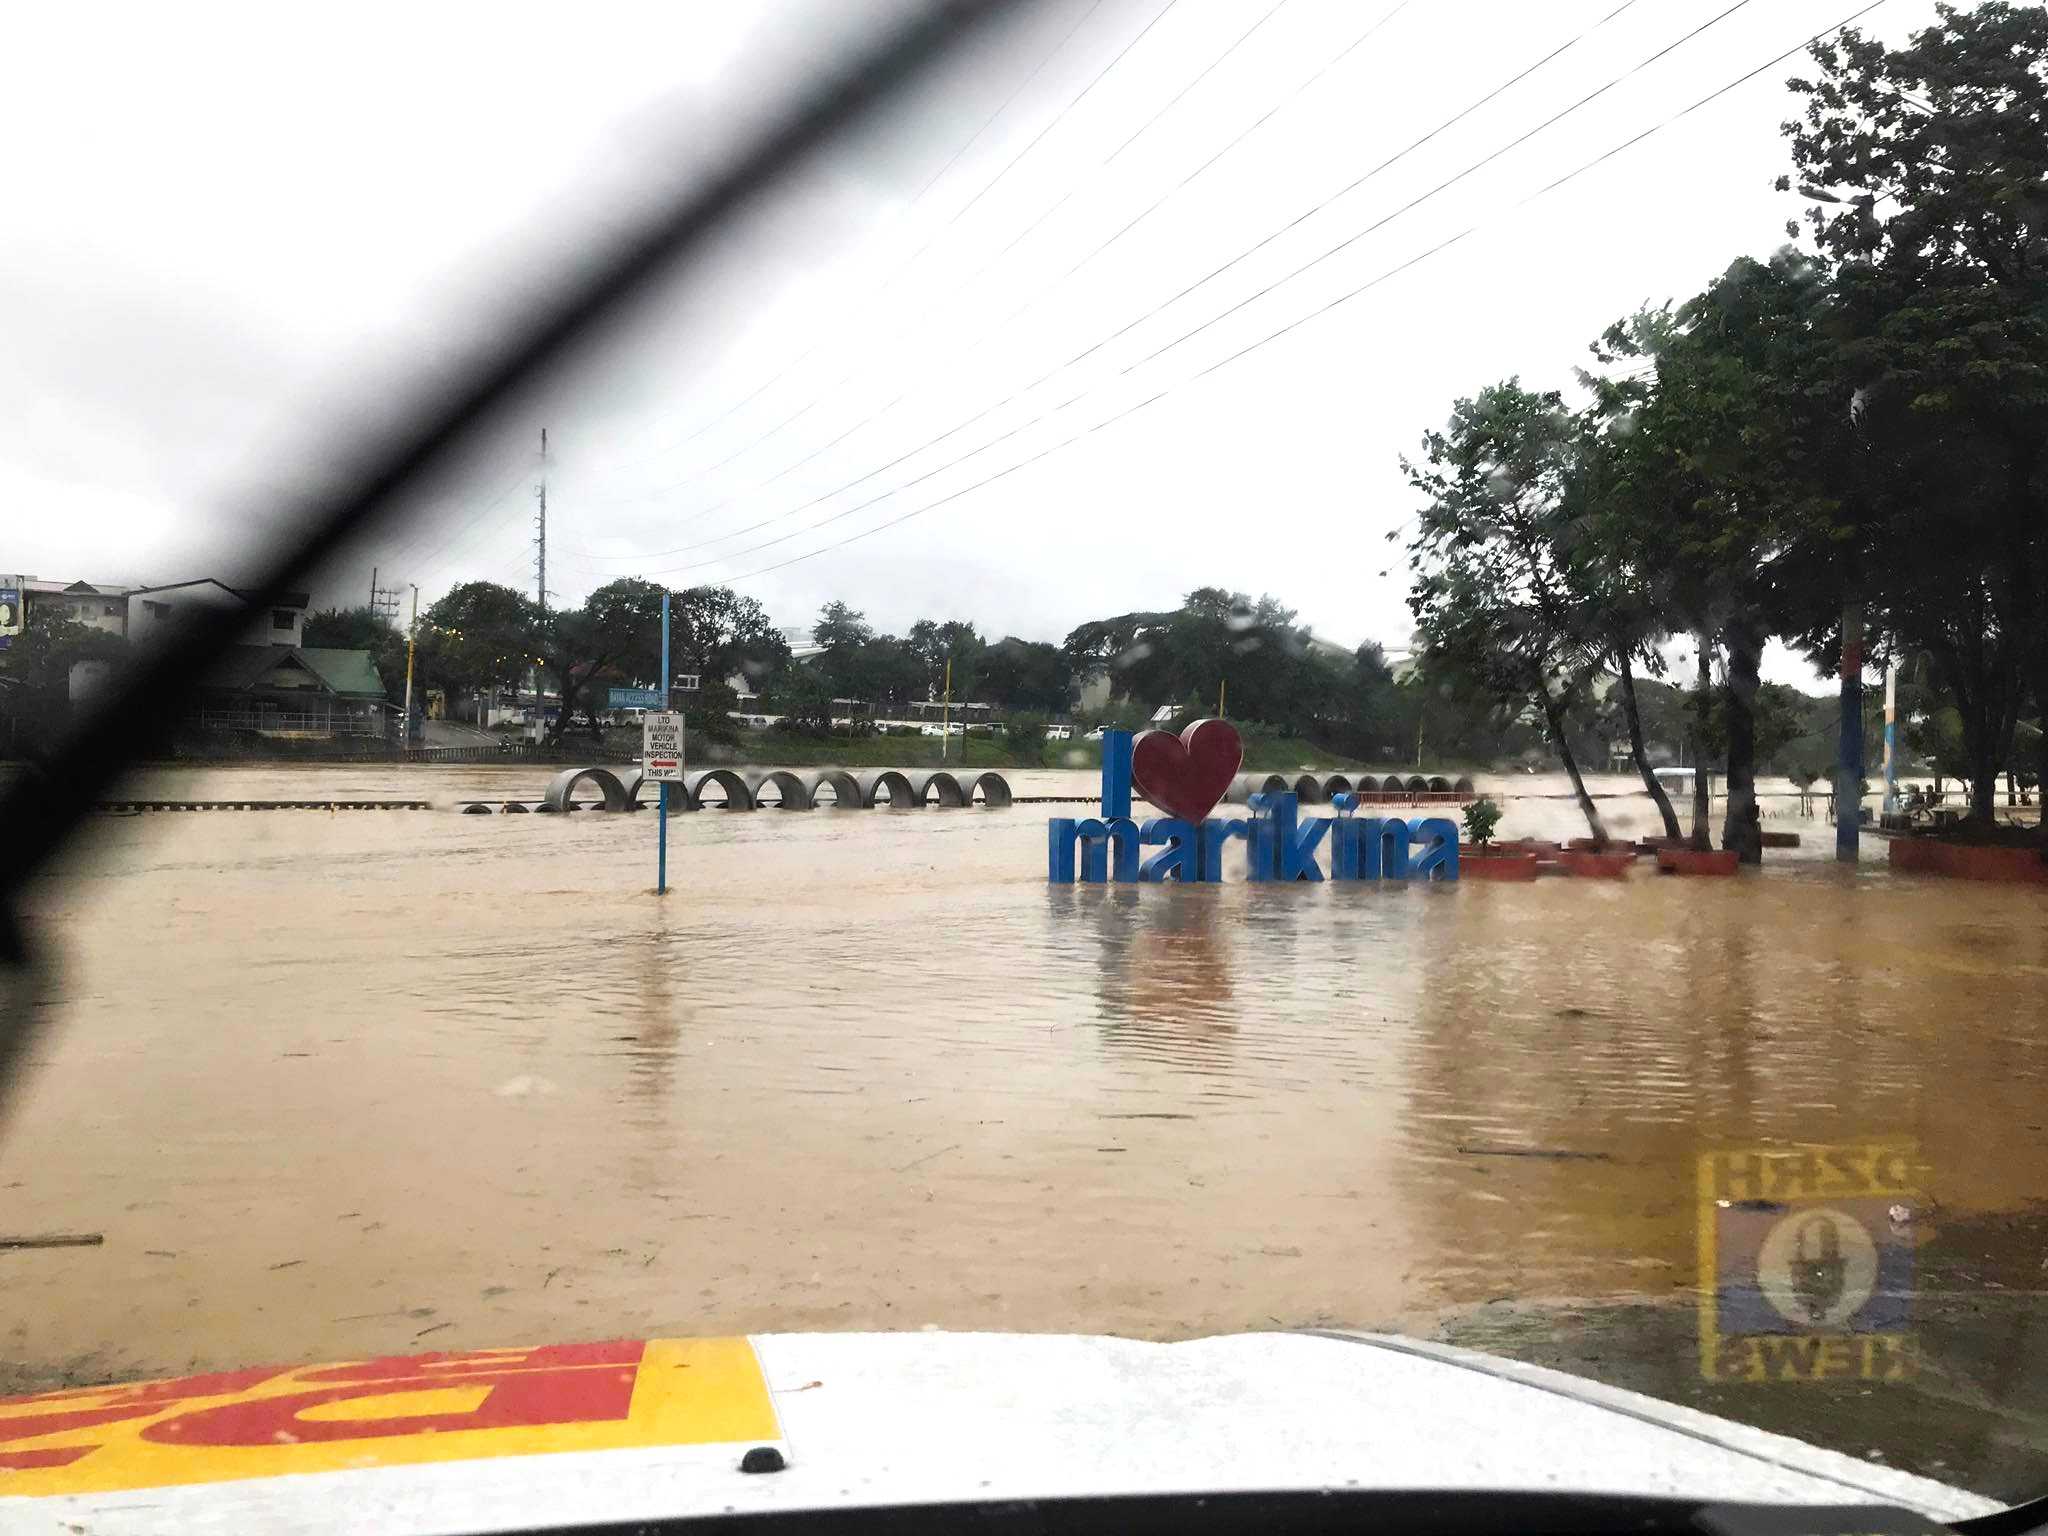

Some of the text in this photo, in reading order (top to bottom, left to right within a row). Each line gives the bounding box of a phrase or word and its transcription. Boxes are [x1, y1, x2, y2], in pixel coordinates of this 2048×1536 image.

[651, 734, 675, 742] MOTOR
[650, 742, 678, 750] VEHICLE
[644, 751, 683, 759] INSPECTION
[647, 769, 663, 777] THIS
[1102, 729, 1133, 818] I
[1048, 790, 1459, 883] marikina
